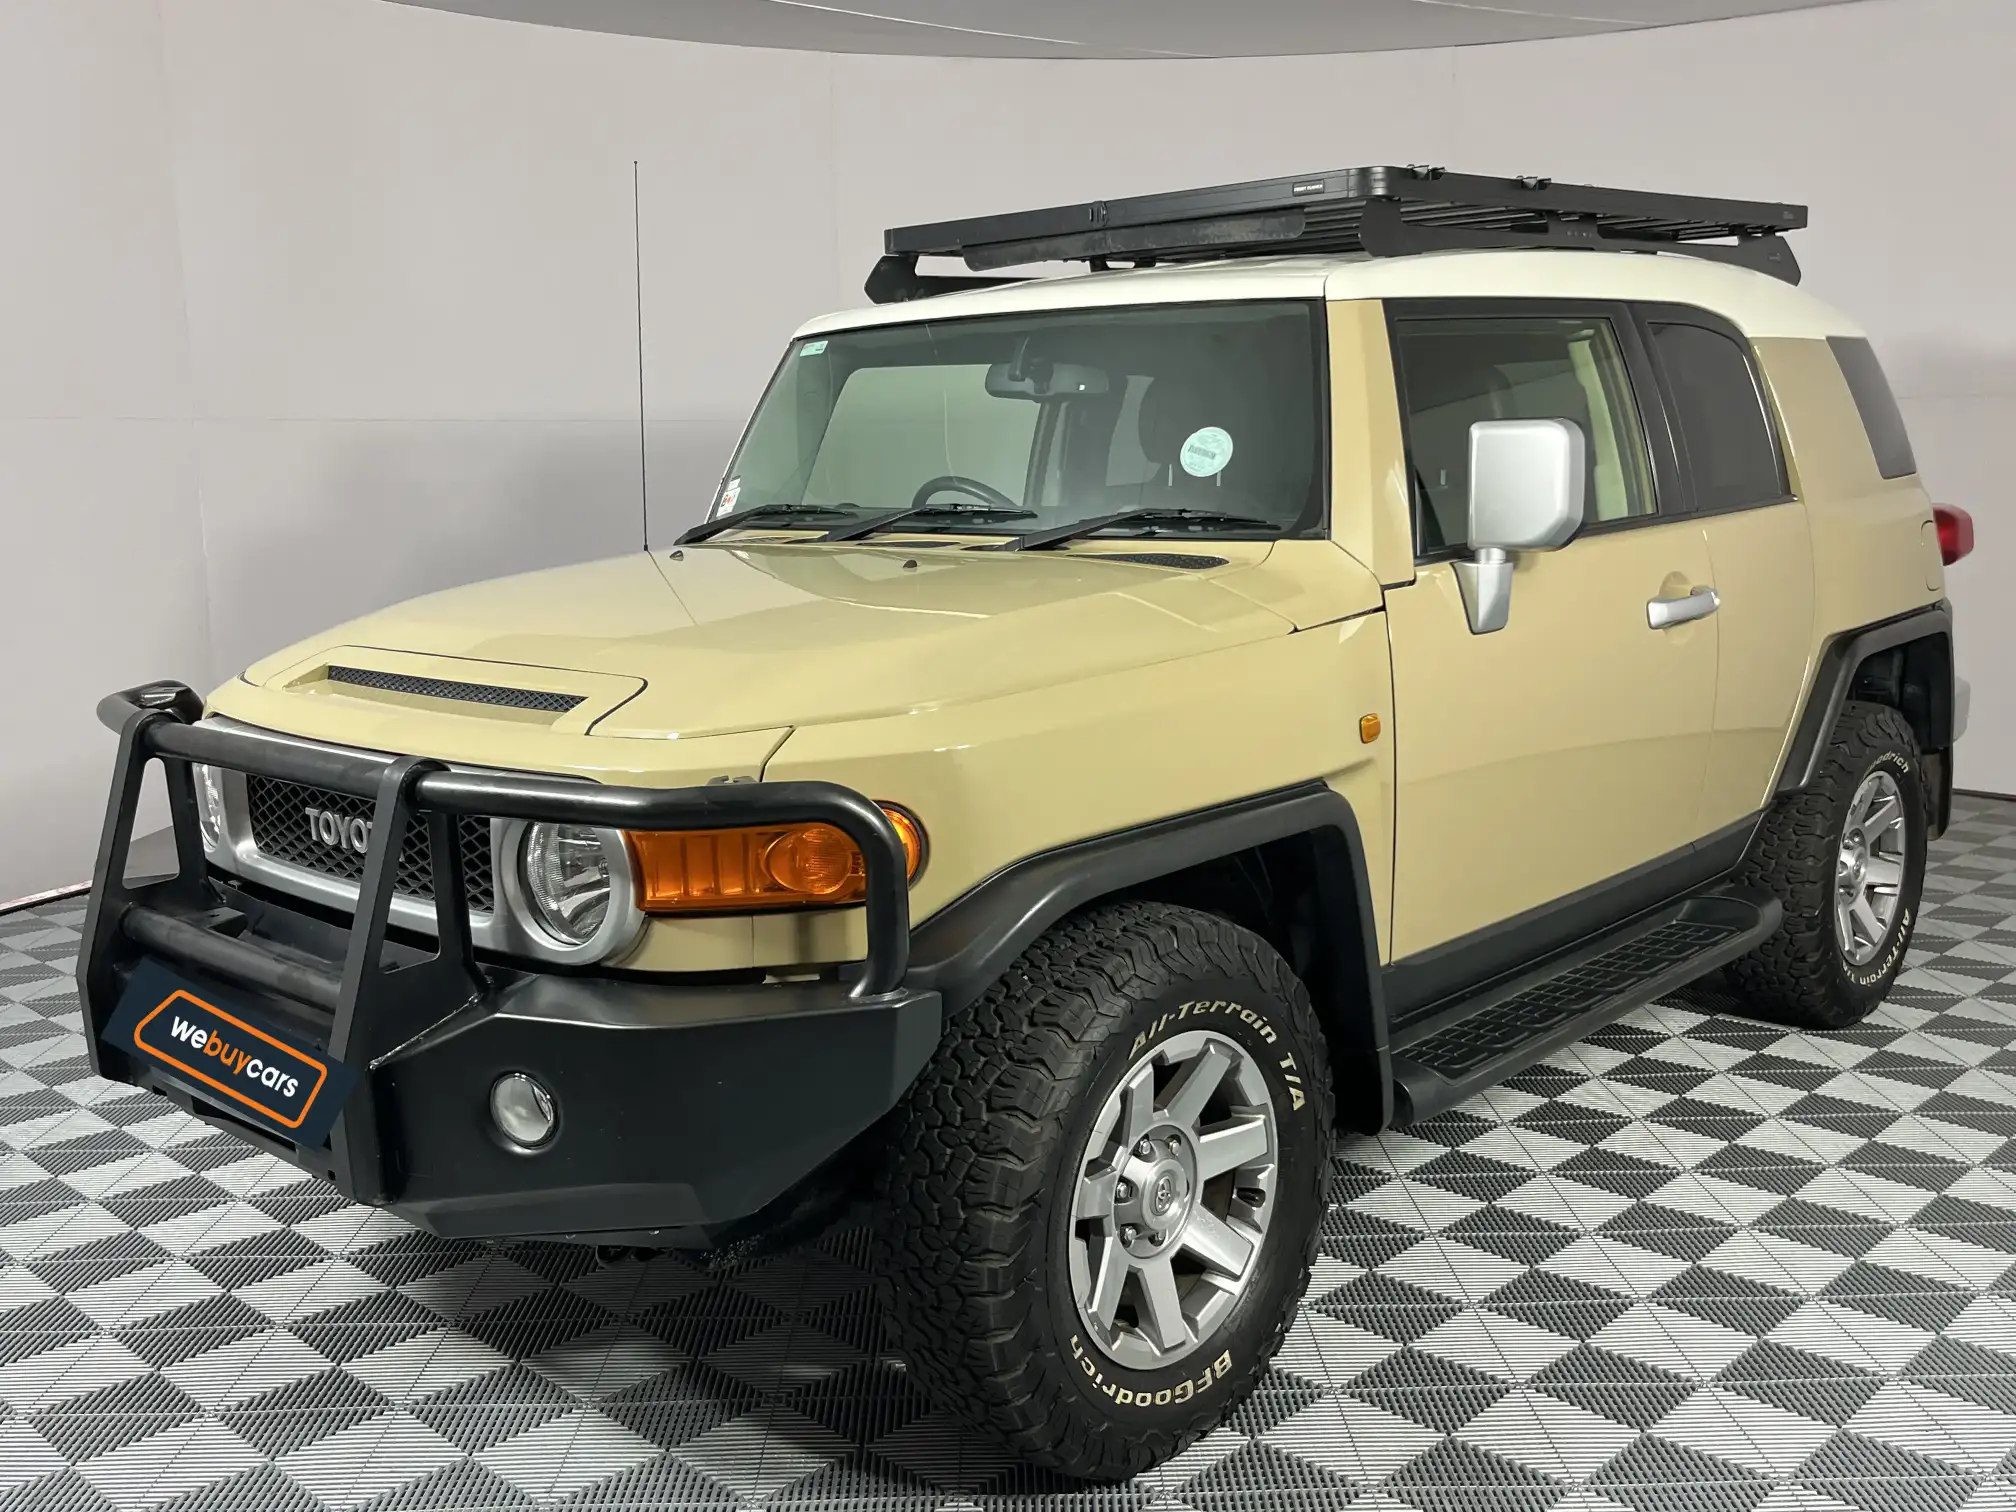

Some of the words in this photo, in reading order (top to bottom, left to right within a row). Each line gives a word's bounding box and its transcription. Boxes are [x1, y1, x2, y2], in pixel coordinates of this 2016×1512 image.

[305, 807, 374, 854] TOYO
[1860, 908, 1910, 987] All-Terrain
[1128, 1000, 1277, 1060] All-Terrain
[1279, 1052, 1306, 1111] T/A
[1070, 1335, 1232, 1407] BFGoodrich
